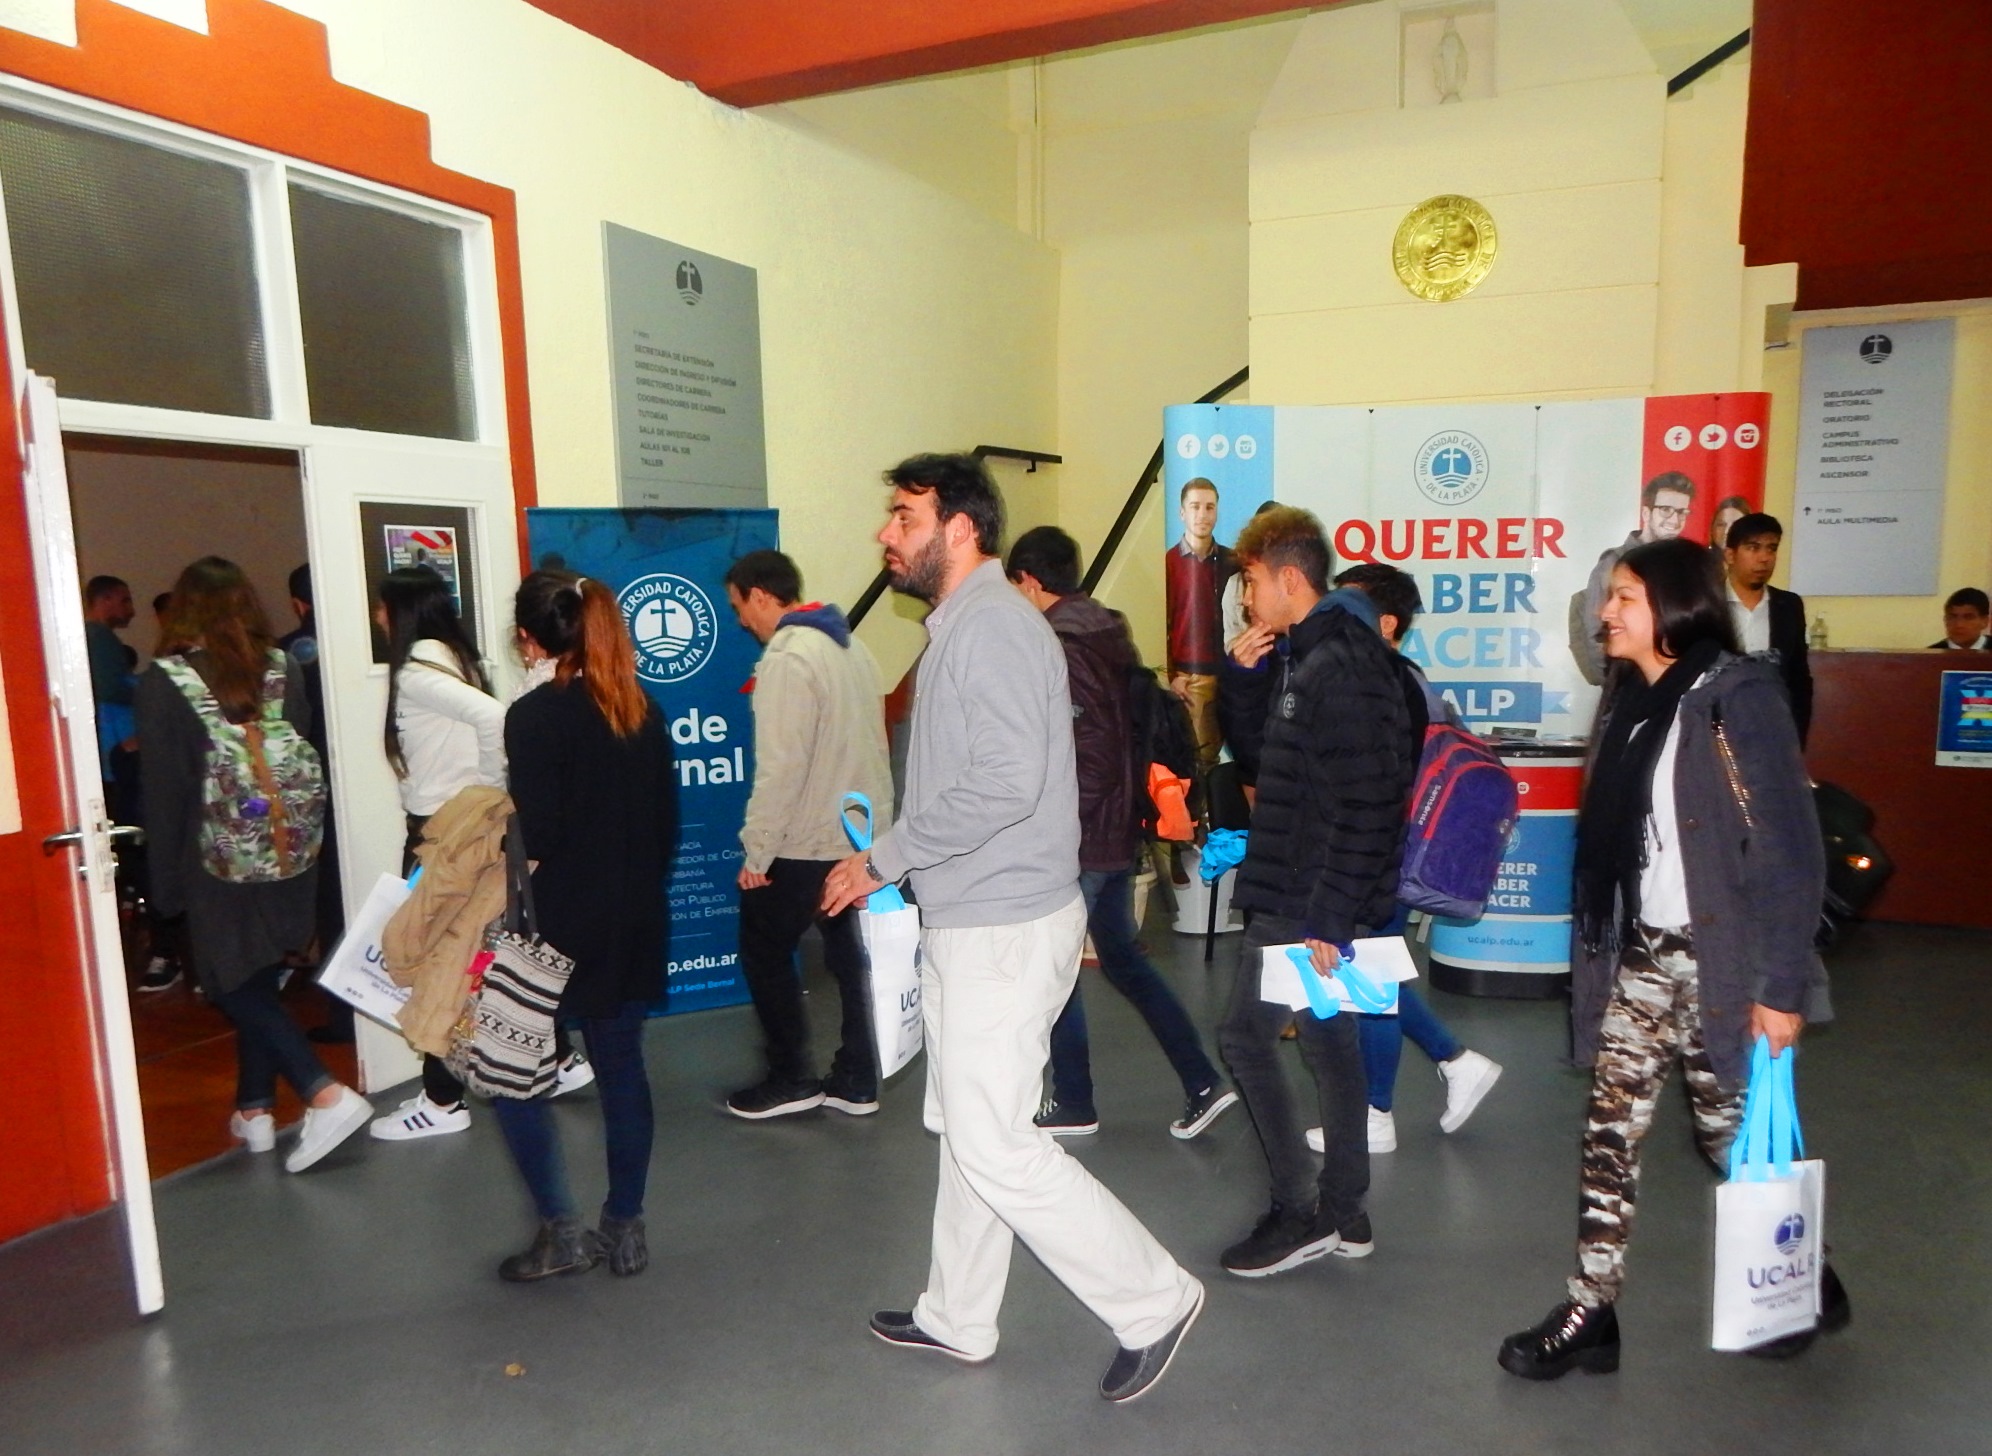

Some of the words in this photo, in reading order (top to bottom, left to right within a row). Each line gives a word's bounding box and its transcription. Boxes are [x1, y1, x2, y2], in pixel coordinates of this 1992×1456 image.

[1823, 388, 1884, 398] DELEGACIÓN
[1823, 399, 1872, 407] RECTORAL
[1822, 414, 1870, 423] ORATORIO
[639, 425, 655, 435] SALA
[1822, 431, 1860, 439] CAMPUS
[1822, 438, 1899, 448] ADMINISTRATIVO
[640, 457, 664, 467] TALLER
[1419, 435, 1459, 476] UNIVERSIDAD
[1460, 438, 1485, 475] CATOLICA
[1820, 454, 1874, 463] BIBLIOTECA
[1819, 470, 1869, 479] ASCENSOR
[1425, 482, 1438, 495] DE
[1437, 490, 1449, 500] LA
[1452, 481, 1478, 500] PLATA
[1843, 516, 1898, 524] MULTIMEDIA
[1334, 517, 1567, 566] QUERER
[674, 585, 710, 637] CATOLICA
[1401, 627, 1543, 669] ACER
[669, 647, 704, 675] PLATA
[648, 663, 665, 675] LA
[669, 708, 728, 745] de
[1418, 784, 1442, 826] Samsonite
[1487, 894, 1532, 908] ACER
[1466, 934, 1536, 947] ucalp.edu.ar
[667, 953, 738, 976] p.edu.ar
[684, 983, 706, 992] Sede
[707, 977, 736, 989] Bernal
